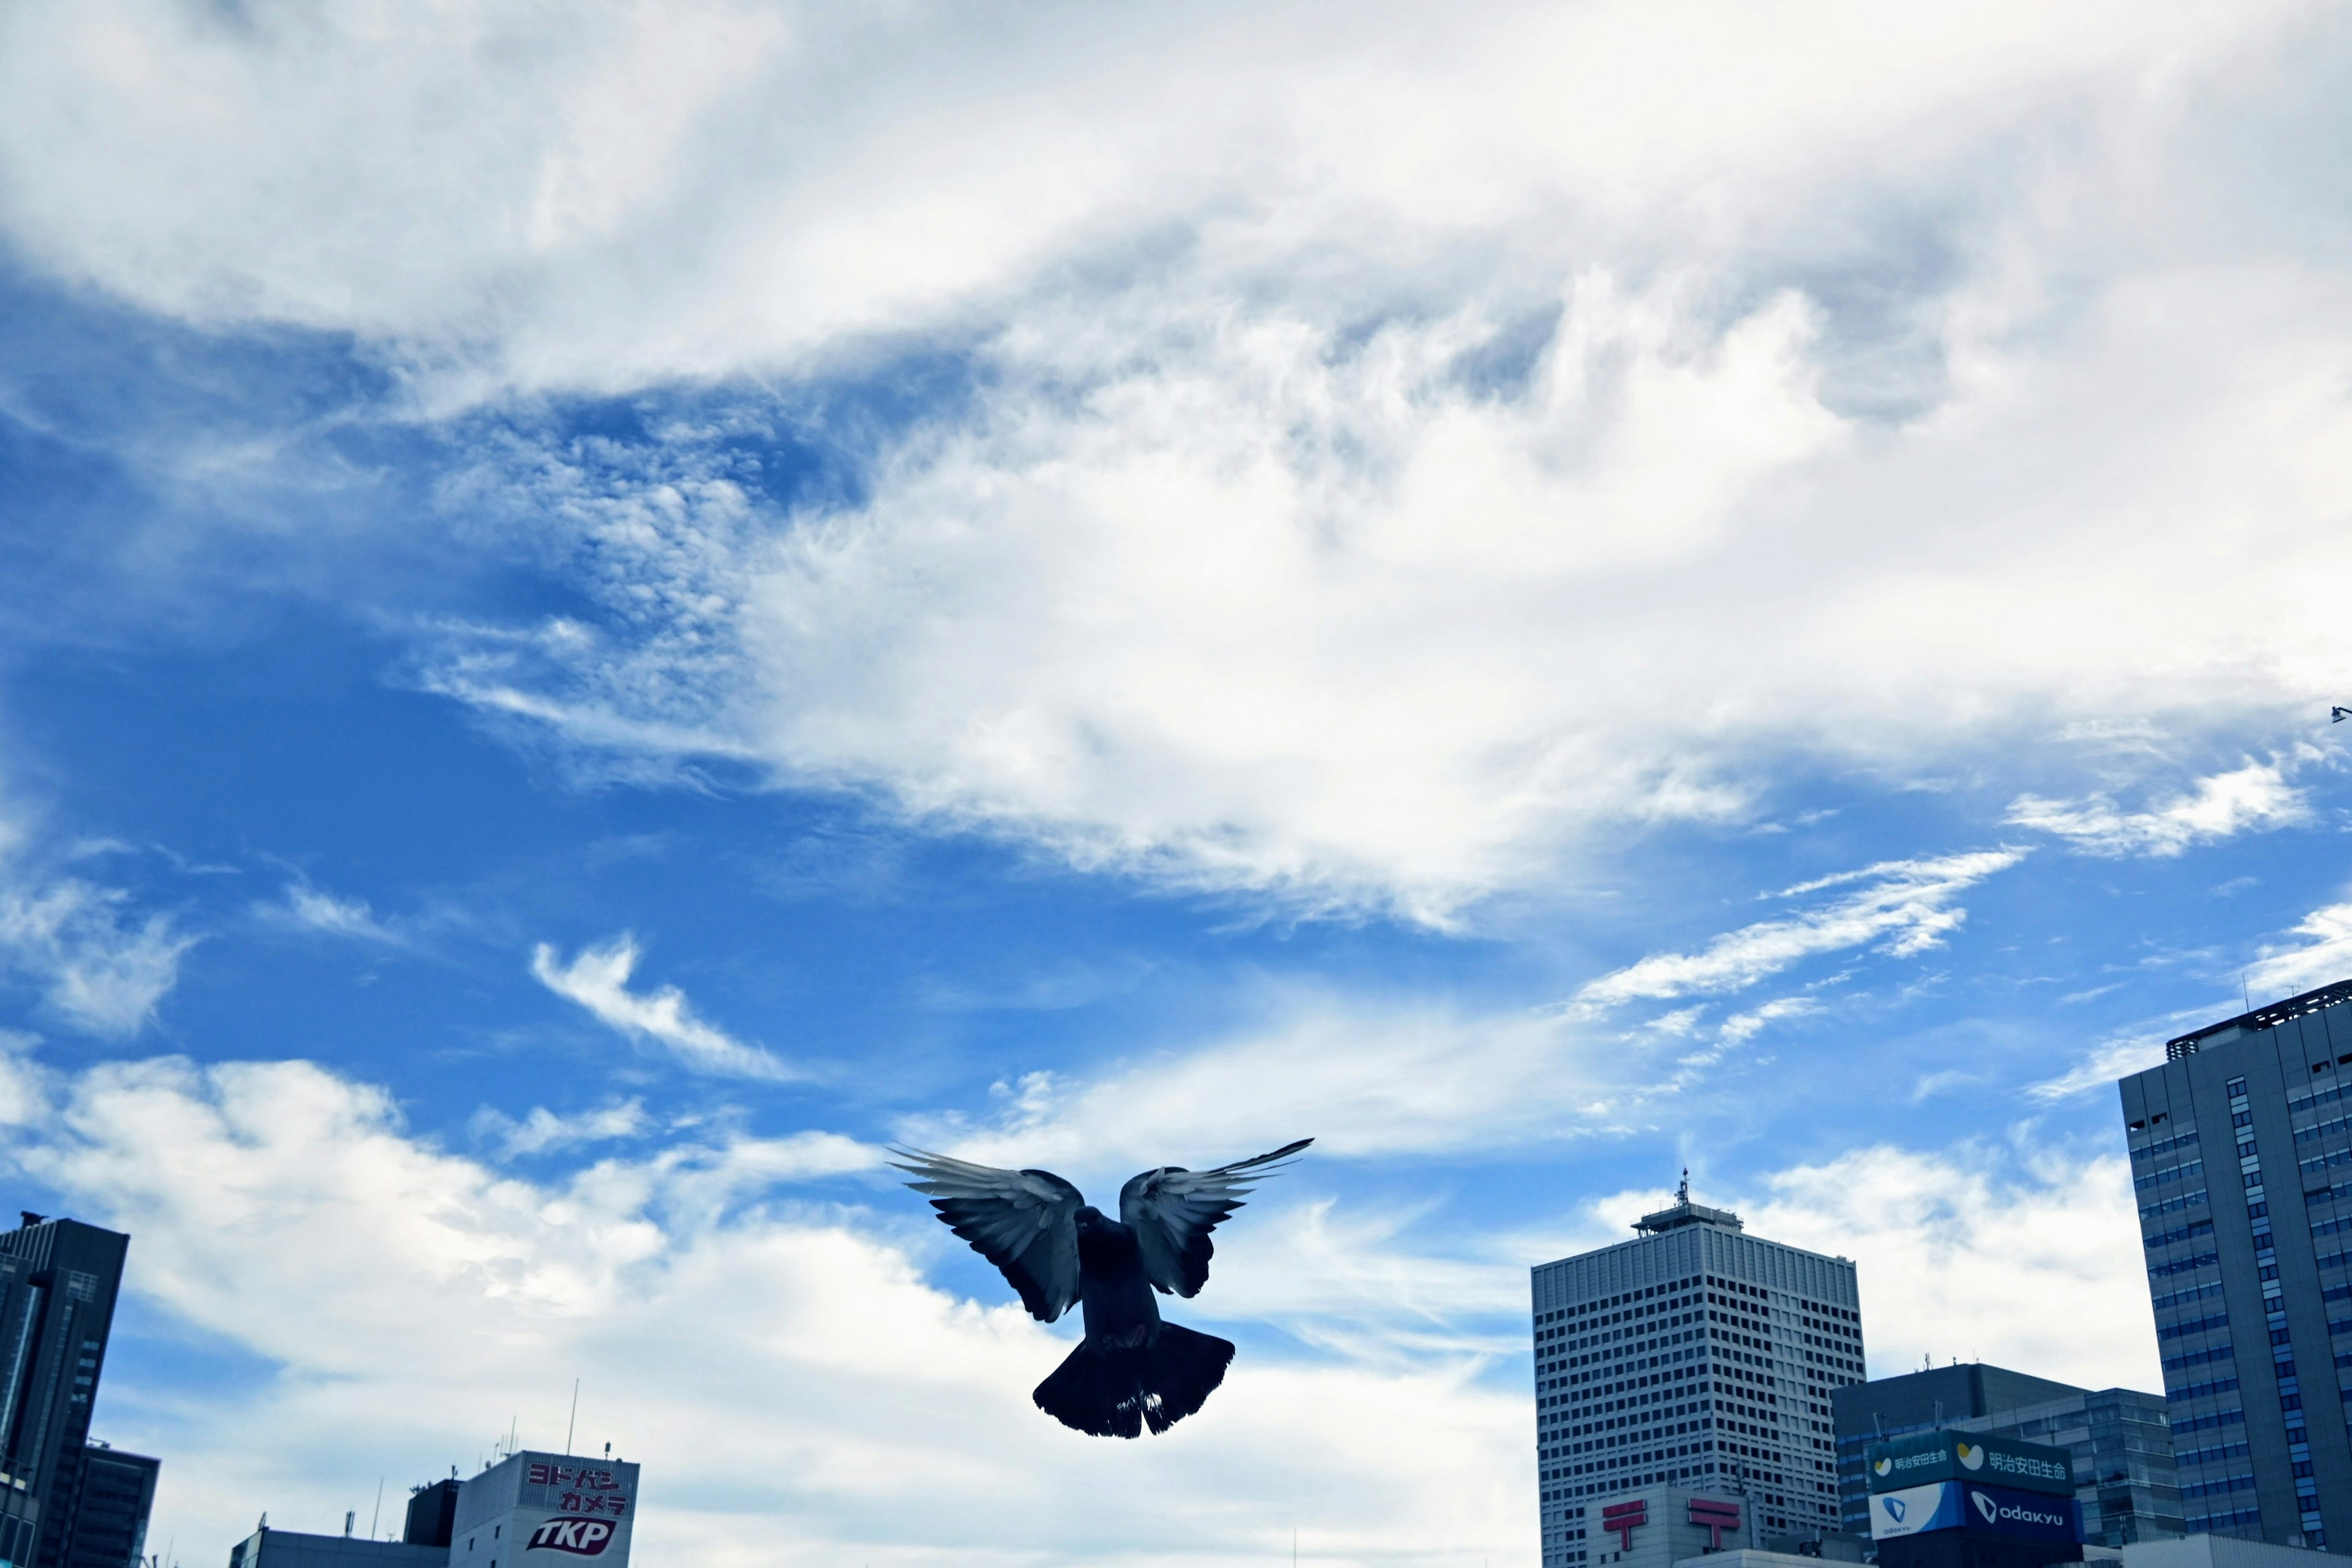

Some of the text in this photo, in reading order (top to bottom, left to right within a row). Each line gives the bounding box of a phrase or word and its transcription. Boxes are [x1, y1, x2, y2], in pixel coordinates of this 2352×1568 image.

[1894, 1449, 1947, 1470] 明治安田生命
[1989, 1452, 2066, 1480] 明治安田生命
[528, 1463, 620, 1491] ヨドバシ
[559, 1491, 628, 1516] カメラ
[2000, 1506, 2063, 1526] odakyu
[537, 1521, 609, 1549] TKP
